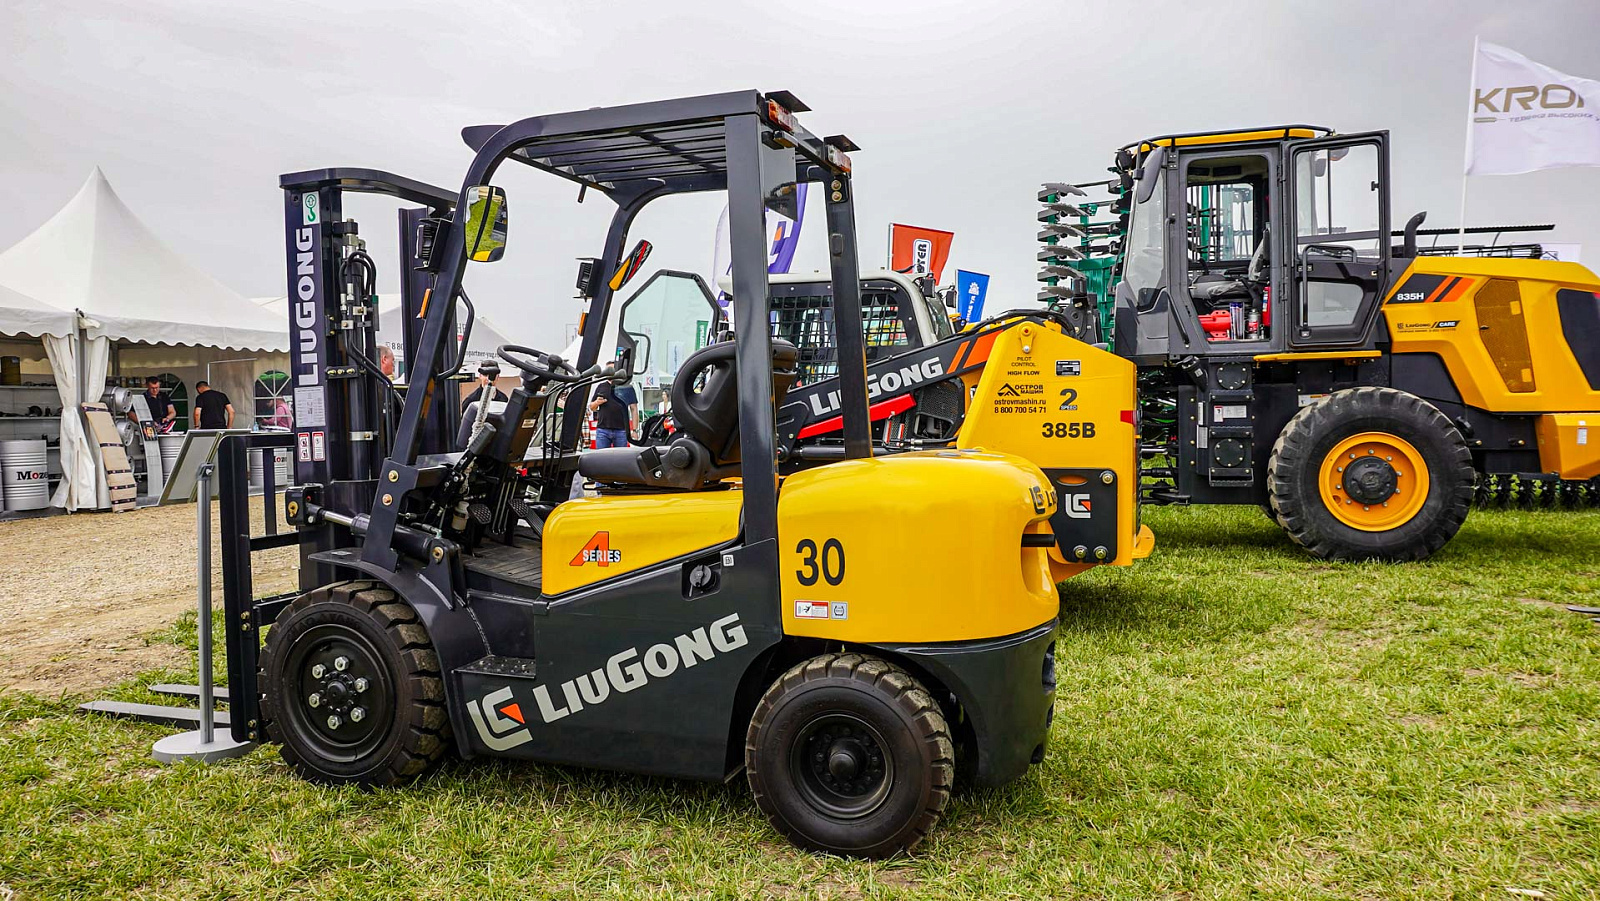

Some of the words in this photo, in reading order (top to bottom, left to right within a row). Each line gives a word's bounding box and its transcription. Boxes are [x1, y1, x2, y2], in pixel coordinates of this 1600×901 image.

[1397, 292, 1424, 301] 835H
[809, 357, 944, 416] LIGONG
[1059, 388, 1078, 411] 2
[1041, 422, 1096, 438] 385B
[569, 531, 609, 567] A
[582, 550, 621, 562] SERIES
[796, 538, 845, 586] 30
